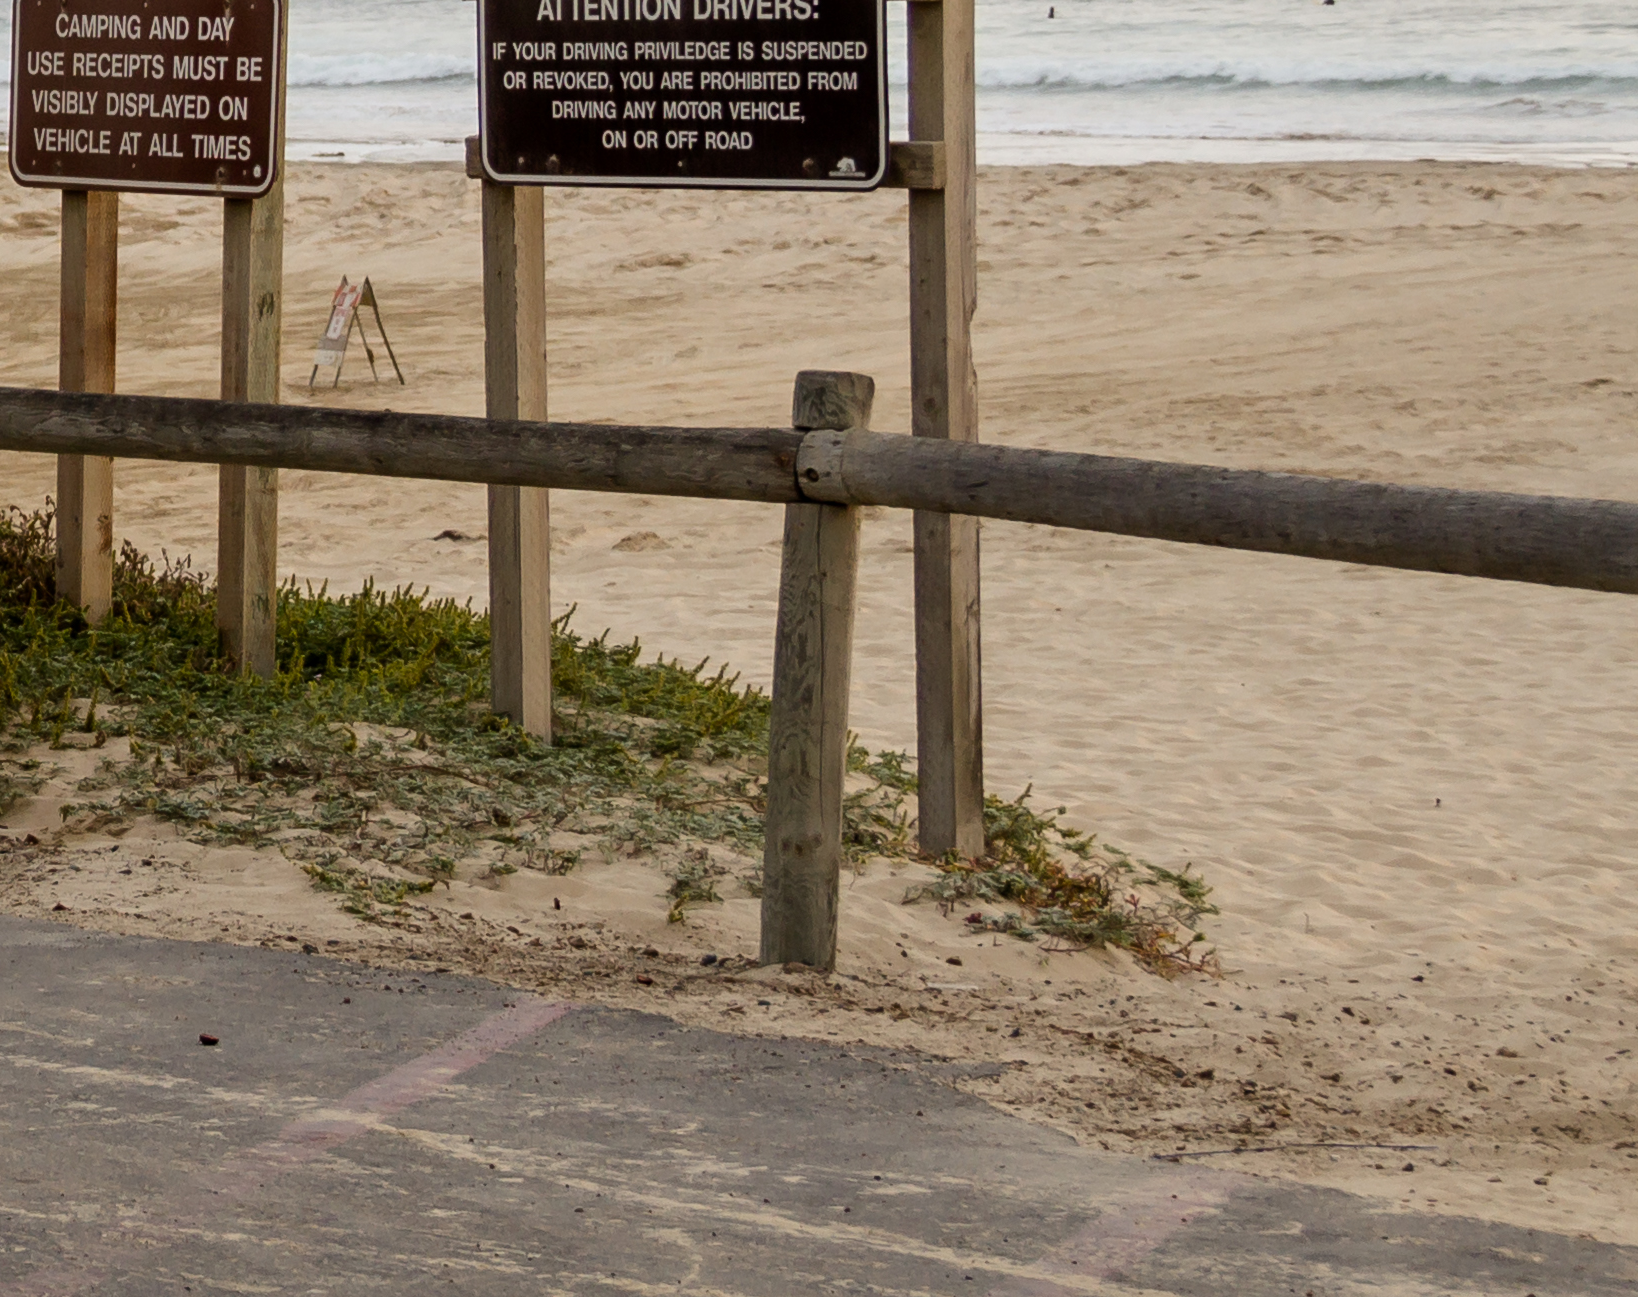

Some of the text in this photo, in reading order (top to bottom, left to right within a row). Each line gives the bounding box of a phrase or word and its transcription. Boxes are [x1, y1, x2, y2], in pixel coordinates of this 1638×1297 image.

[55, 13, 234, 41] CAMPING AND DAY
[493, 41, 867, 60] IF YOUR DRIVING PRIVILEDGE IS SUSPENDED
[27, 51, 262, 81] USE RECEIPTS MUST BE
[503, 72, 857, 93] OR REVOKED, YOU ARE PROHIBITED FROM
[32, 89, 248, 120] VISIBLY DISPLAYED ON
[552, 102, 805, 123] DRIVING ANY MOTOR VEHICLE,
[34, 128, 250, 161] VEHICLE AT ALL TIMES
[602, 131, 752, 150] ON OR OFF ROAD
